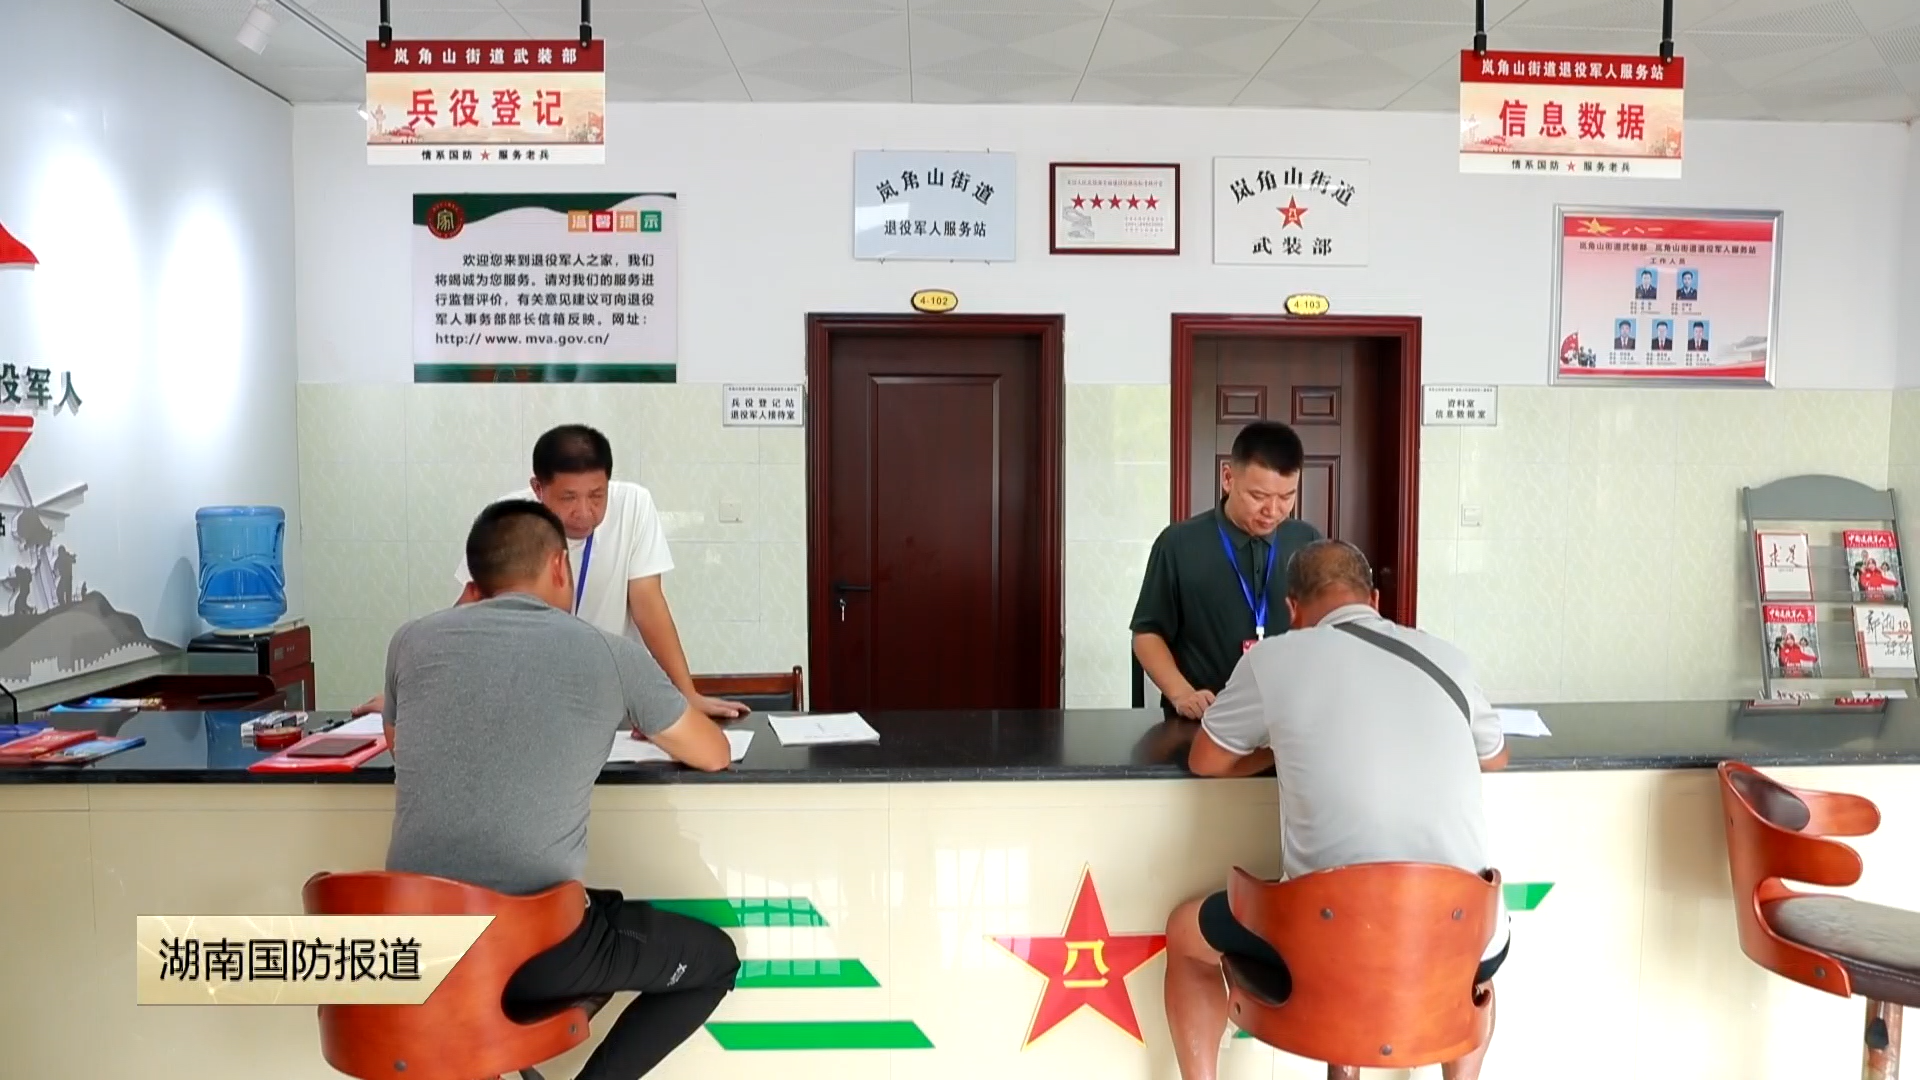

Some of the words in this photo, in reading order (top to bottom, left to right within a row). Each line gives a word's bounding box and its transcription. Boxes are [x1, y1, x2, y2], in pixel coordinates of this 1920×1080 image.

[394, 47, 577, 65] 岚角山街道武装部
[1481, 58, 1664, 81] 岚角山街道退役军人服务站
[407, 88, 564, 127] 兵役登记
[1498, 99, 1645, 141] 信息数据
[421, 150, 473, 161] 情系国防
[498, 150, 550, 161] 服务老兵
[1512, 159, 1560, 171] 情系国防
[1583, 161, 1631, 173] 服务老兵
[876, 167, 995, 205] 岚角山街道
[1230, 166, 1356, 207] 岚角山街道
[884, 219, 987, 238] 退役军人服务站
[1252, 236, 1332, 256] 武装部
[1651, 257, 1686, 265] 工作人员
